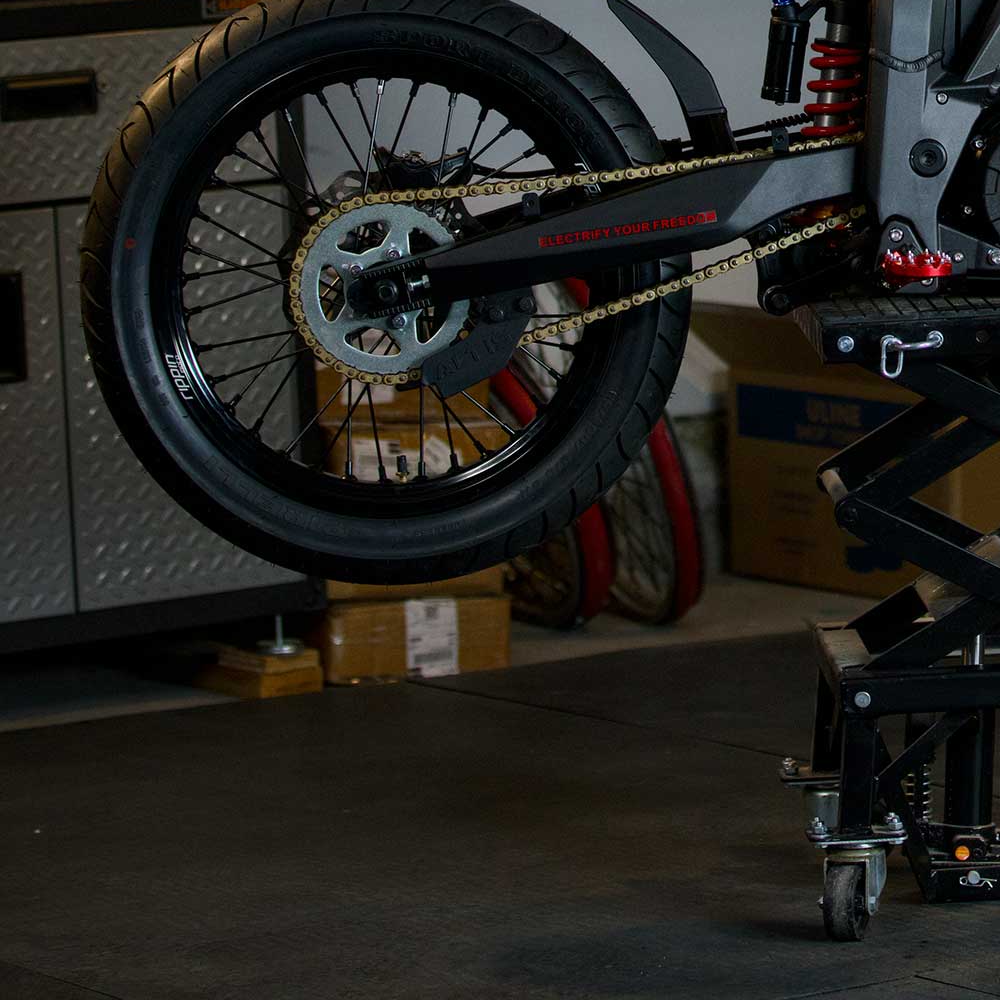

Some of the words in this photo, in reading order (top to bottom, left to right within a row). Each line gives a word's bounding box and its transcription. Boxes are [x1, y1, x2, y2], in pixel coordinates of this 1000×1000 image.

[539, 227, 610, 248] ELECTRIFY
[613, 221, 650, 236] YOUR
[165, 354, 193, 399] rippin
